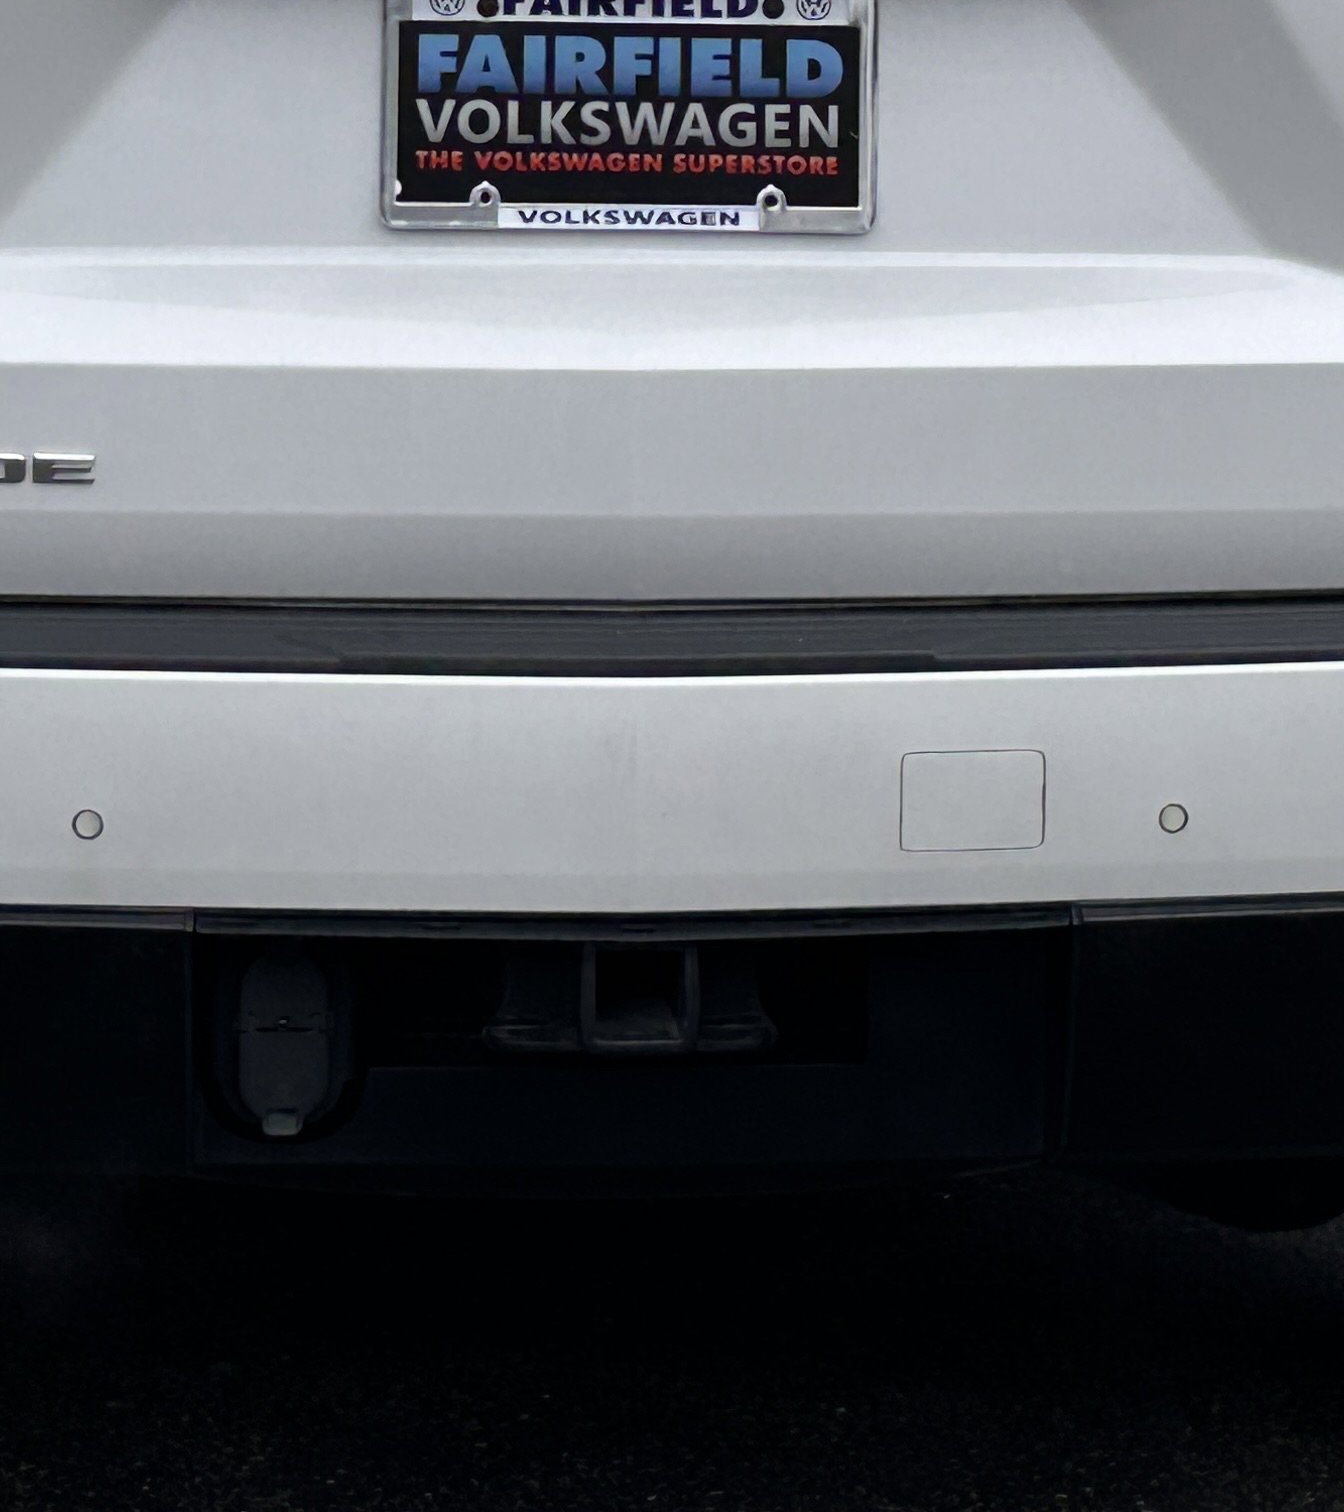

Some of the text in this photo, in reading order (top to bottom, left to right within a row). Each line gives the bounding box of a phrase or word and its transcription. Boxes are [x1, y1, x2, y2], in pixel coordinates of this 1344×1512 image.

[417, 33, 844, 99] FAIRFIELD
[415, 99, 839, 148] VOLKSWAGEN
[415, 150, 839, 176] THE VOLKSWAGEN SUPERSTORE
[518, 209, 740, 226] VOLKSWAGEN
